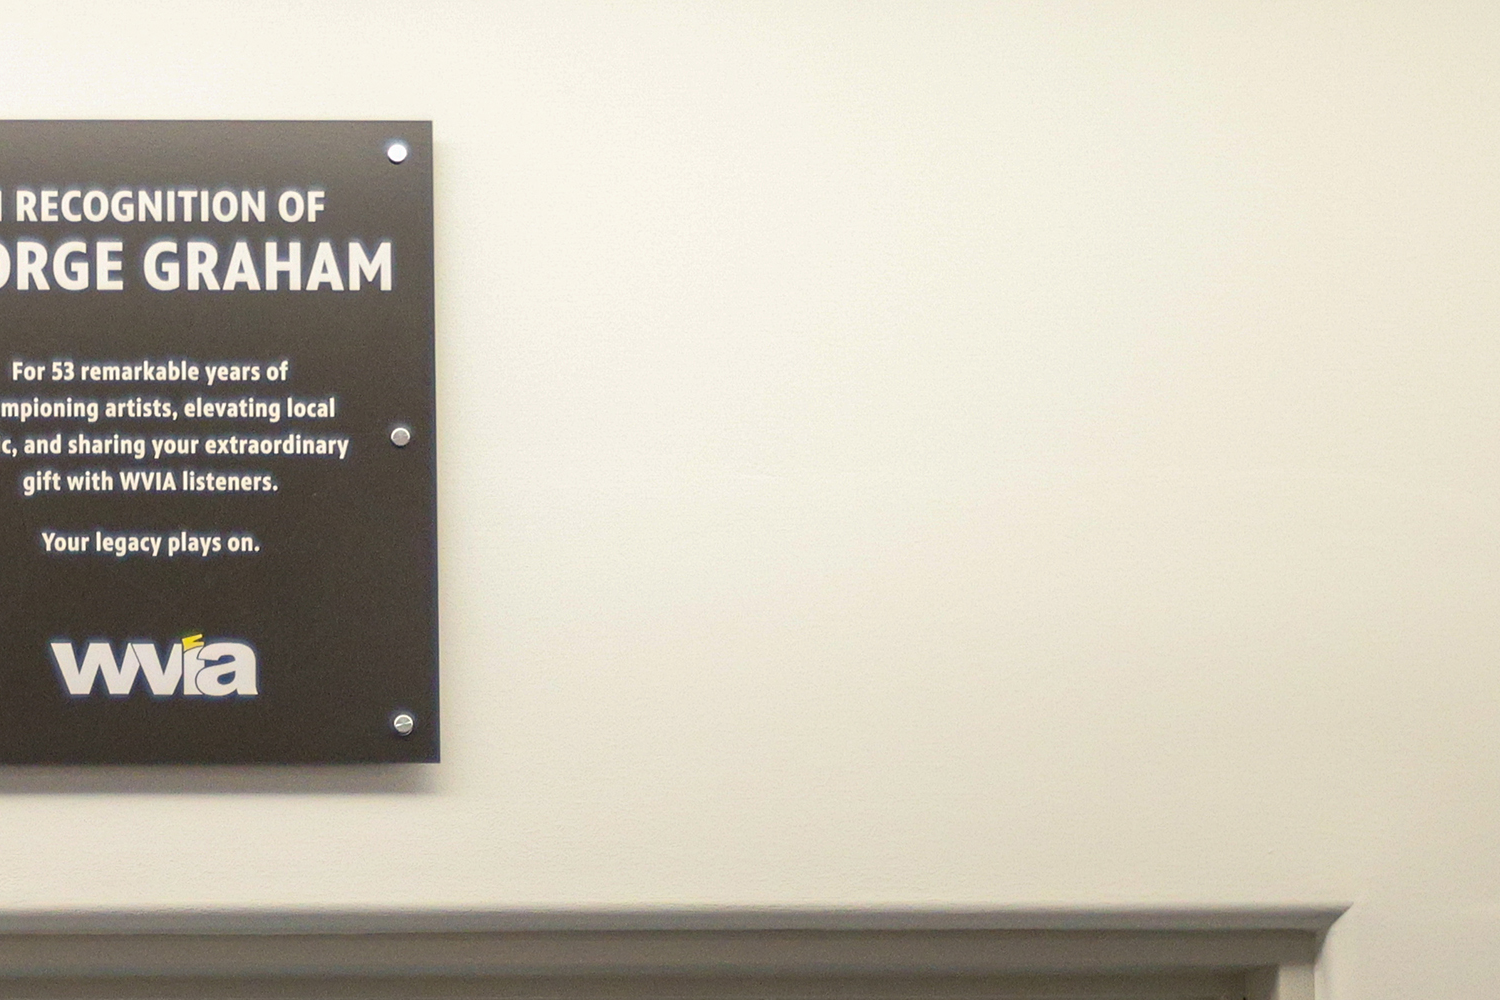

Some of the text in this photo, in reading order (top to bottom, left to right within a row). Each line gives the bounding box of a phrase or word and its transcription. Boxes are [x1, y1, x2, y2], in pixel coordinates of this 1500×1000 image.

[15, 186, 266, 223] RECOGNITION
[277, 186, 326, 223] OF
[143, 238, 393, 292] GRAHAM
[12, 359, 289, 386] For 53 remarkable years of
[104, 396, 178, 421] artists,
[183, 396, 281, 423] elevating
[287, 396, 336, 418] local
[23, 433, 62, 455] and
[67, 433, 146, 460] sharing
[151, 438, 200, 460] your
[204, 433, 350, 460] extraordinary
[22, 469, 279, 497] gift with WVIA listeners.
[41, 530, 260, 557] Your legacy plays on.
[50, 633, 259, 697] wvia
